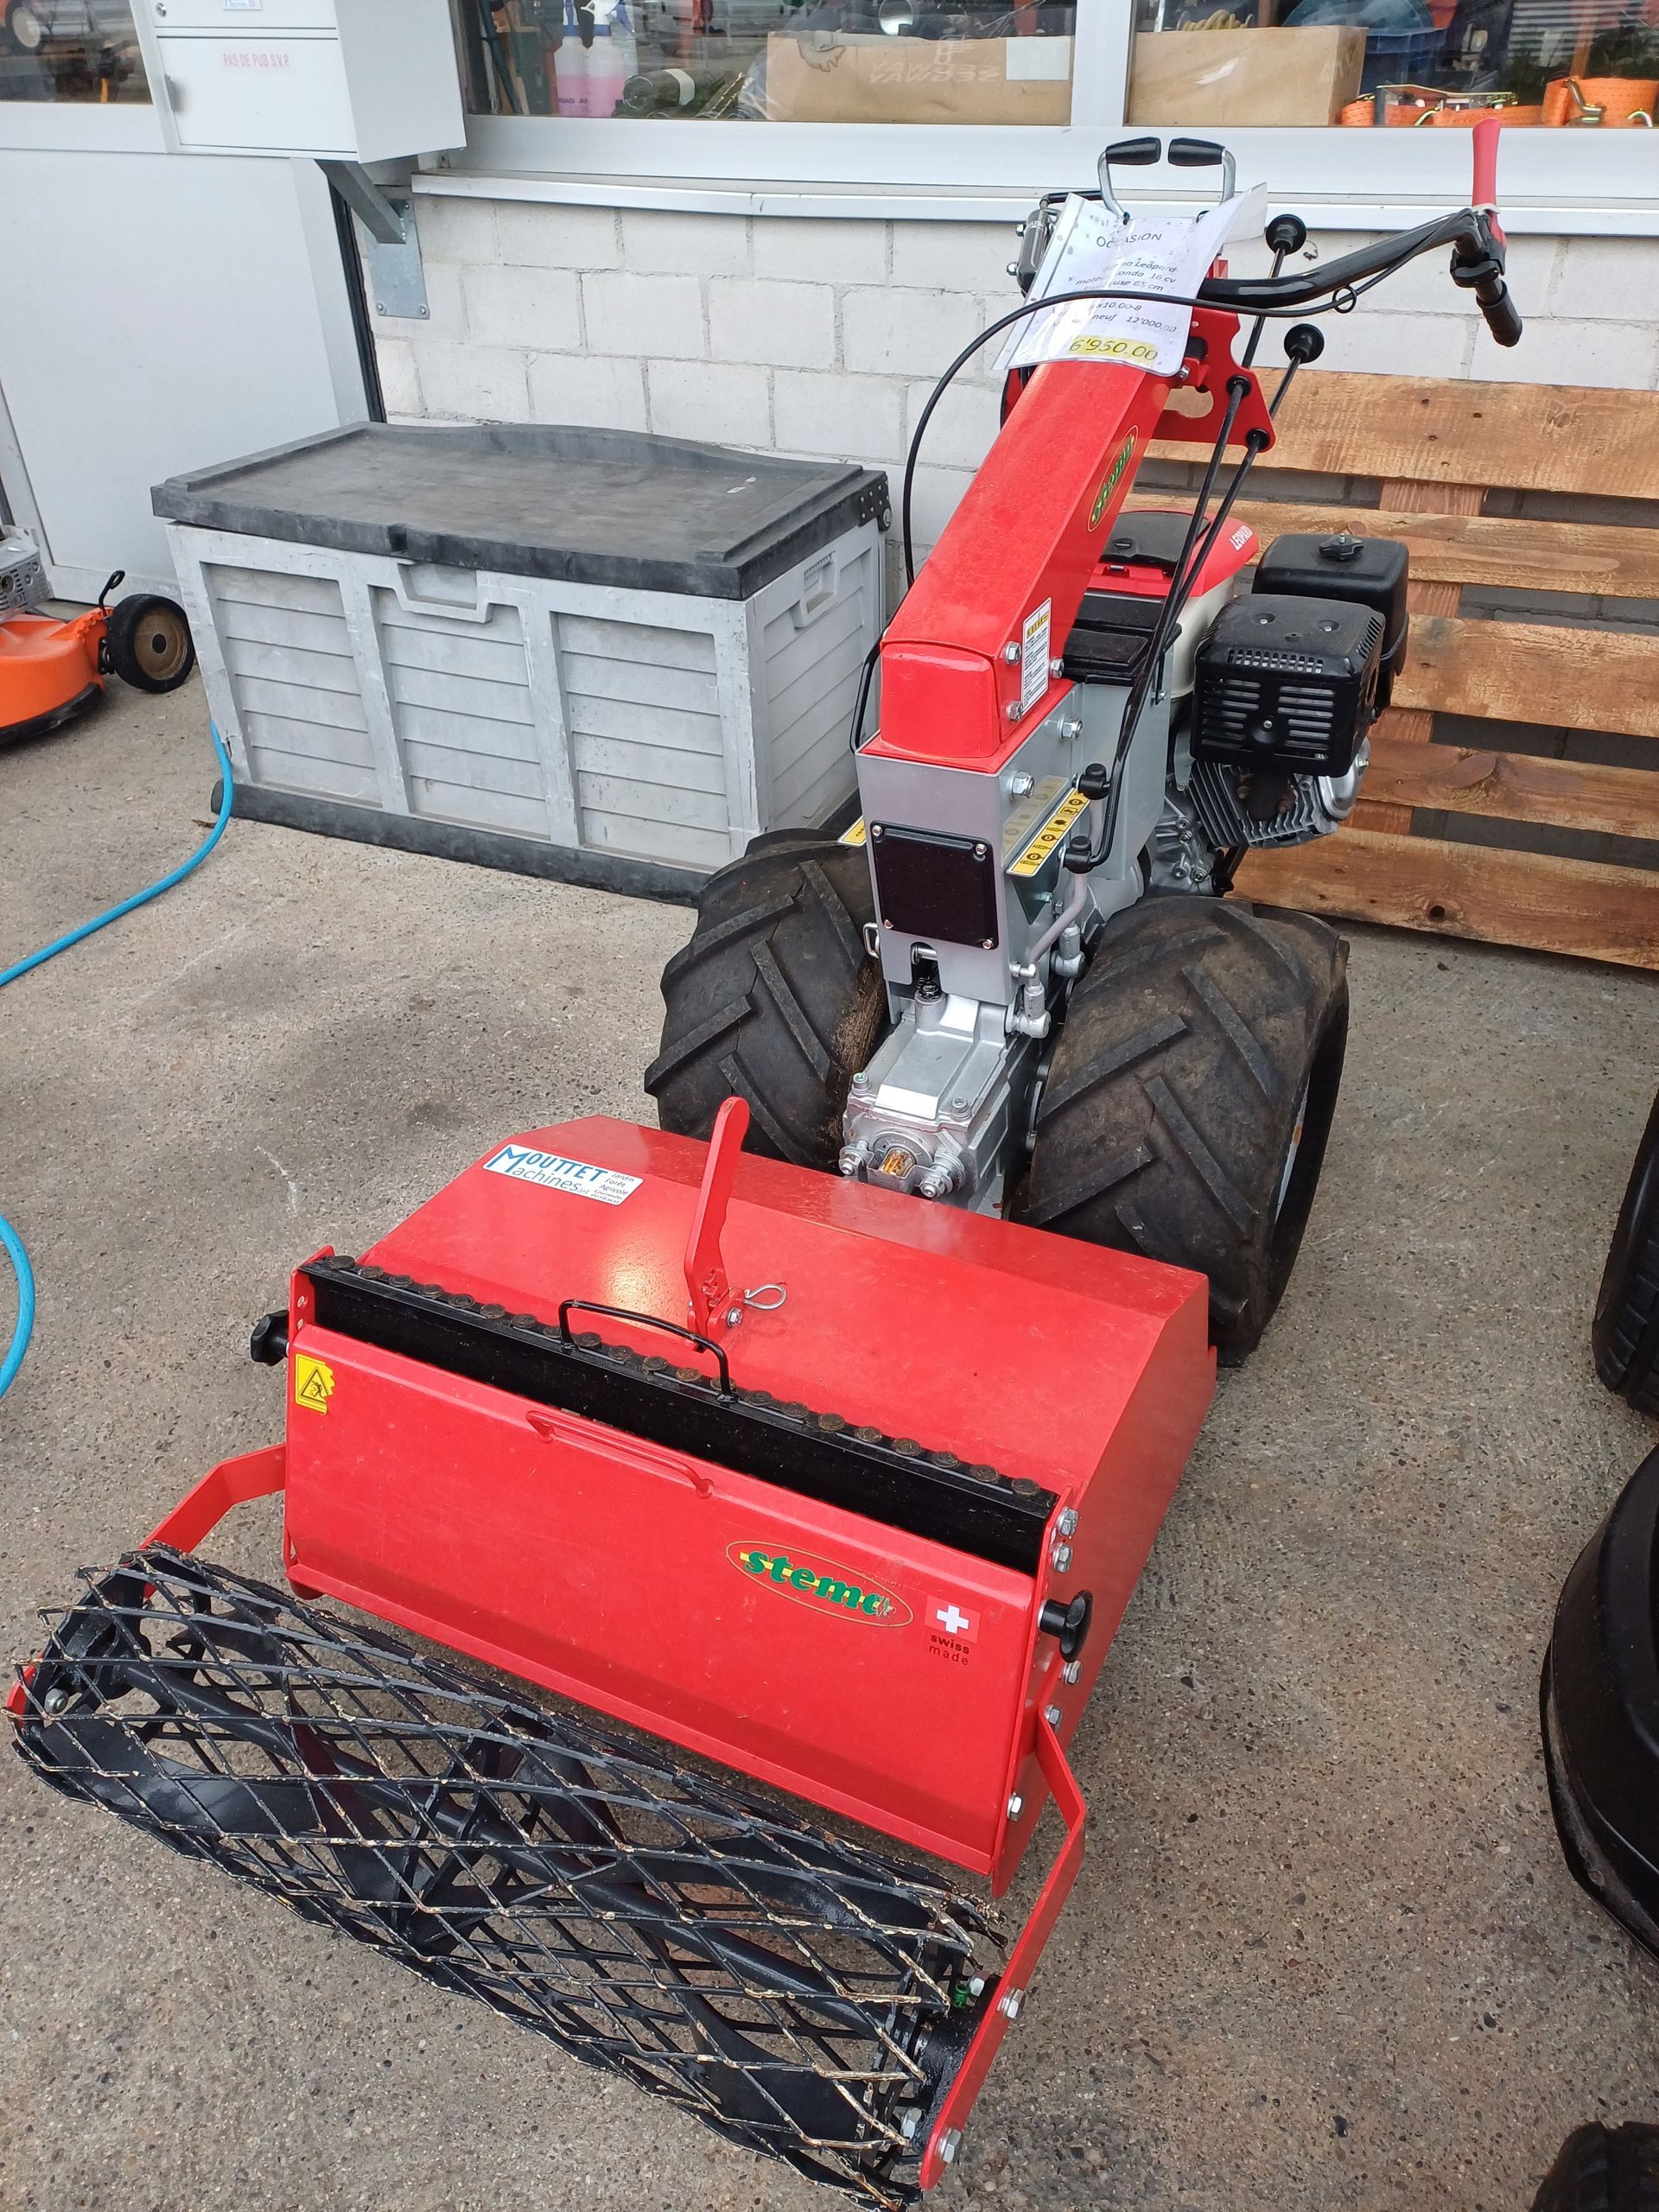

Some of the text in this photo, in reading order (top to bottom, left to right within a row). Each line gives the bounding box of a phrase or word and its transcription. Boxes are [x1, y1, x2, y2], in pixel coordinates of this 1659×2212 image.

[223, 54, 238, 67] PAS
[240, 54, 251, 67] DE
[252, 54, 269, 67] PUB
[1096, 232, 1162, 248] OCASION
[1070, 339, 1158, 360] 6'950.00
[486, 1147, 609, 1182] MOUTTET
[931, 1634, 970, 1655] swiss
[929, 1645, 969, 1666] made
